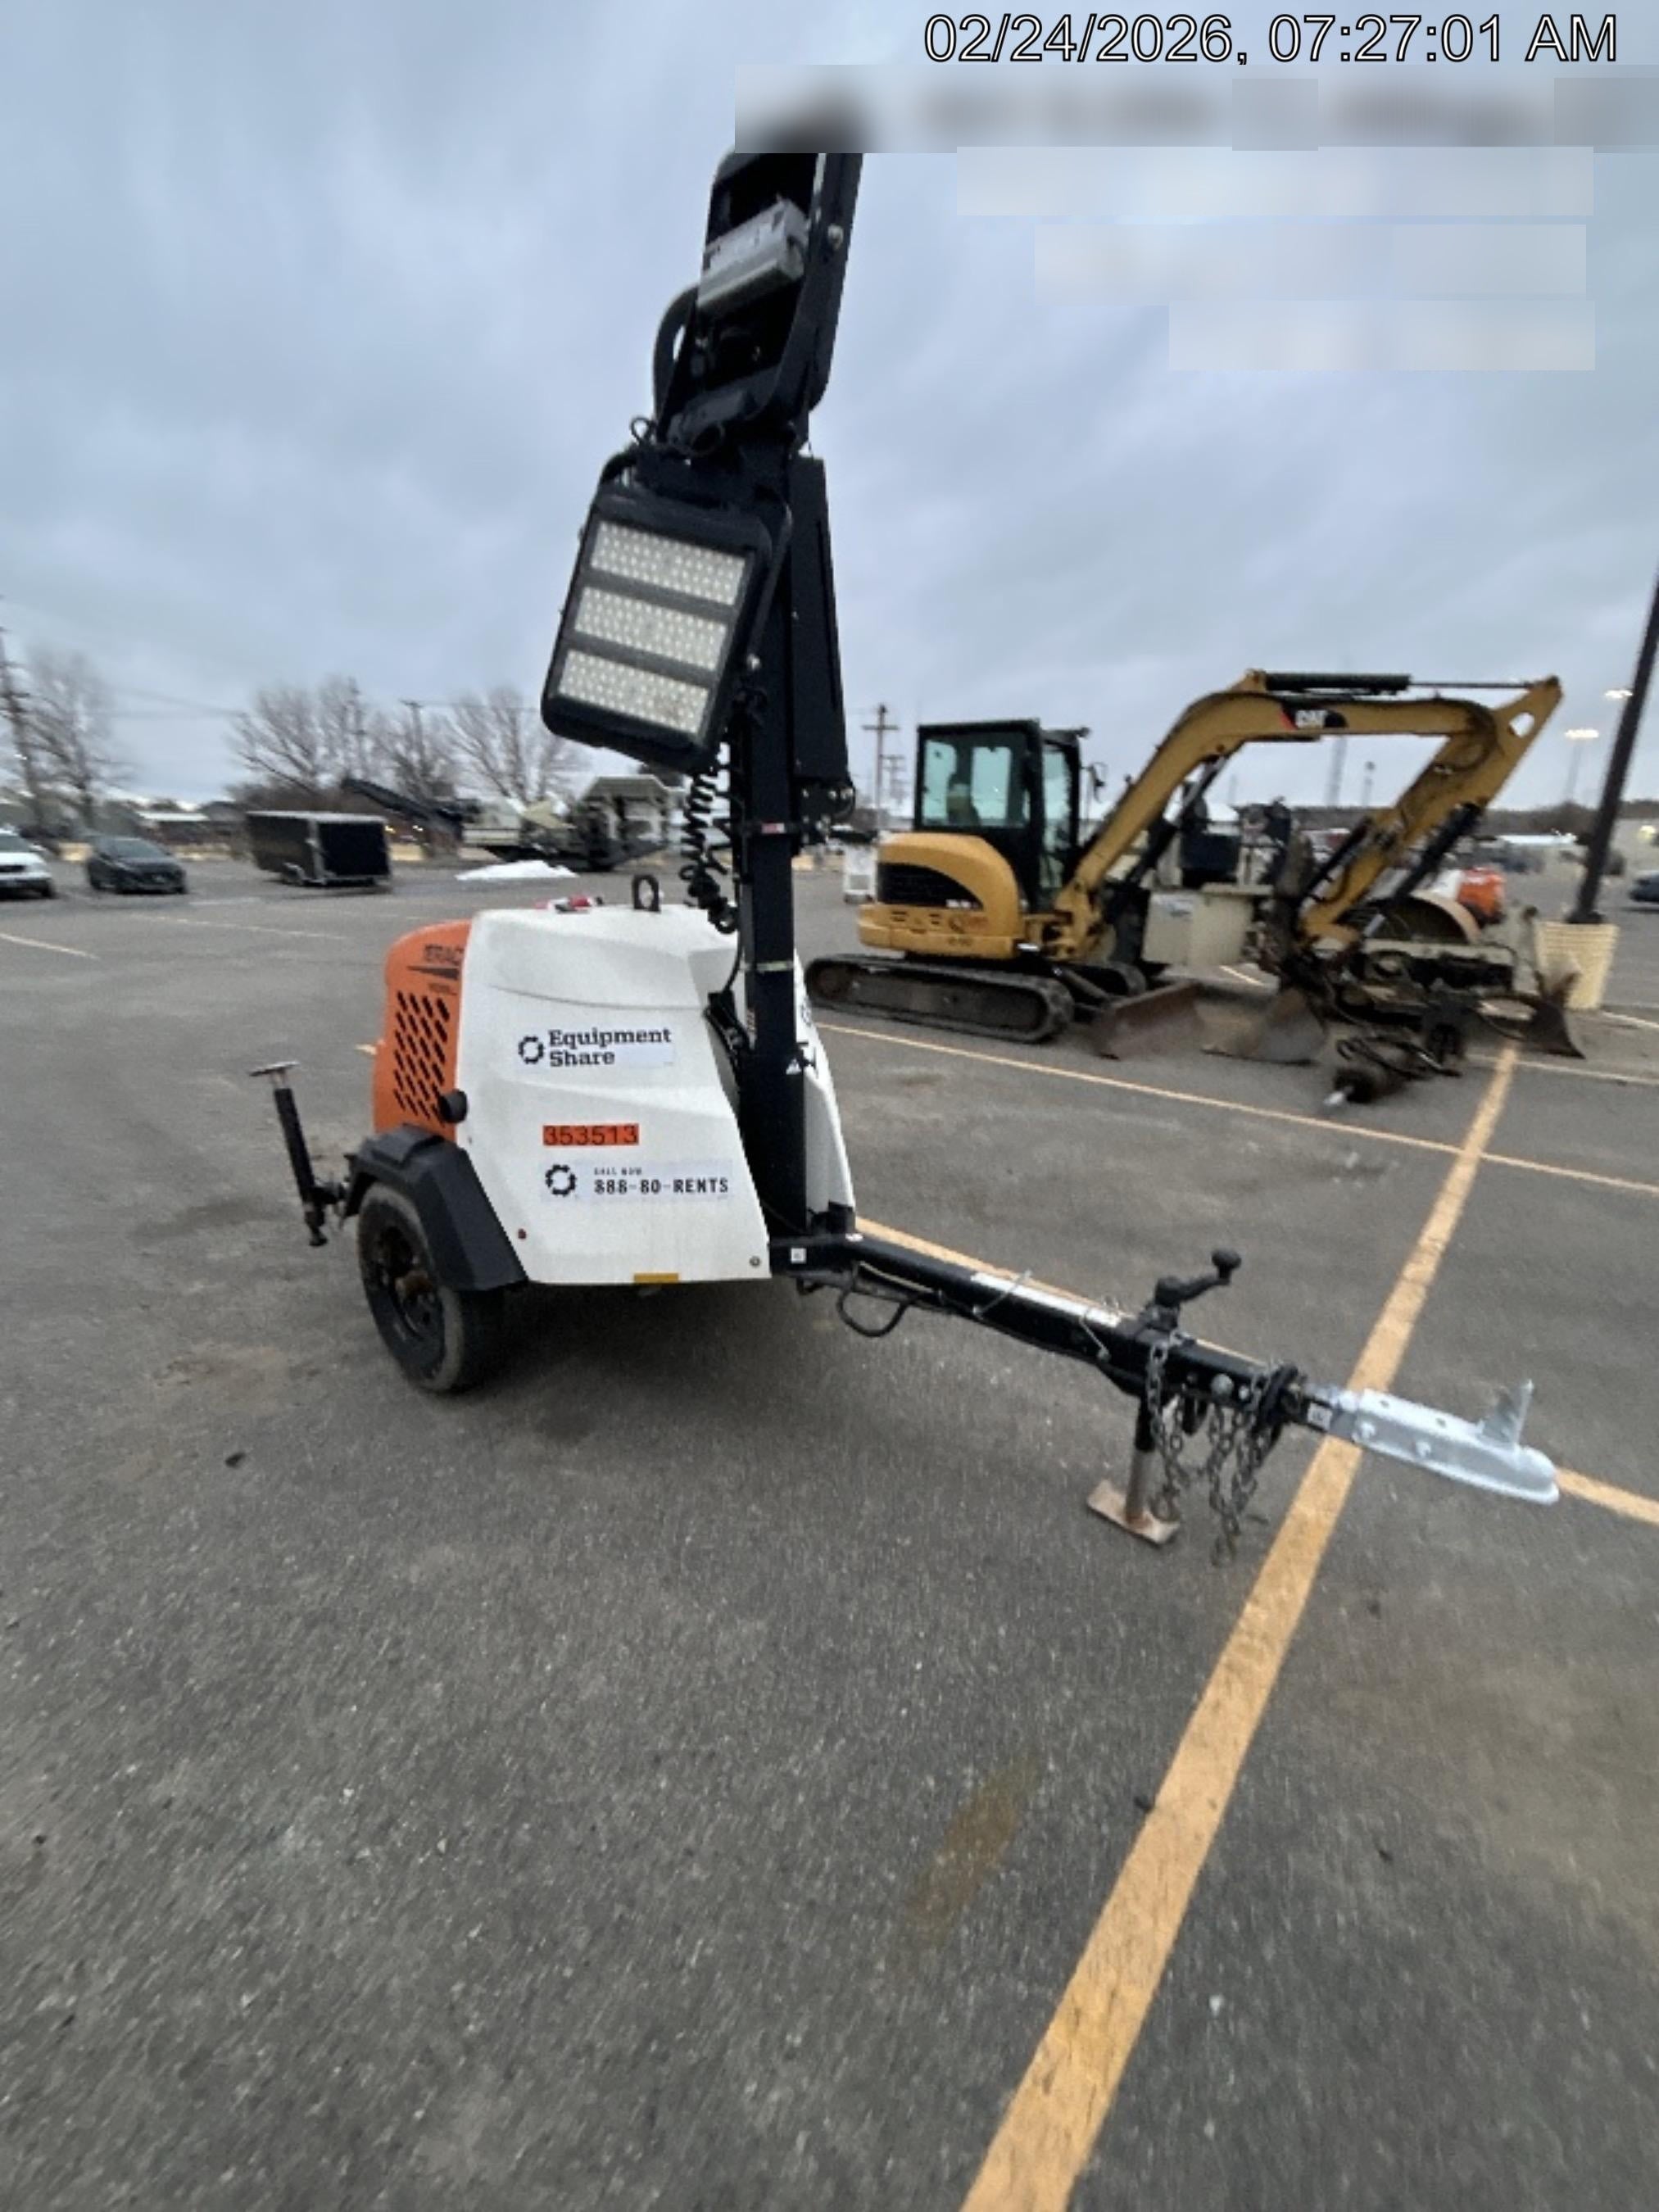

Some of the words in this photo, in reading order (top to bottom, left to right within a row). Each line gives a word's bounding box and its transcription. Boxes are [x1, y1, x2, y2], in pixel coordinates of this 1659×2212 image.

[548, 1027, 672, 1049] Equipment
[550, 1049, 615, 1067] Share
[543, 1124, 638, 1145] 353513
[594, 1177, 728, 1195] 888-80-RENTS
